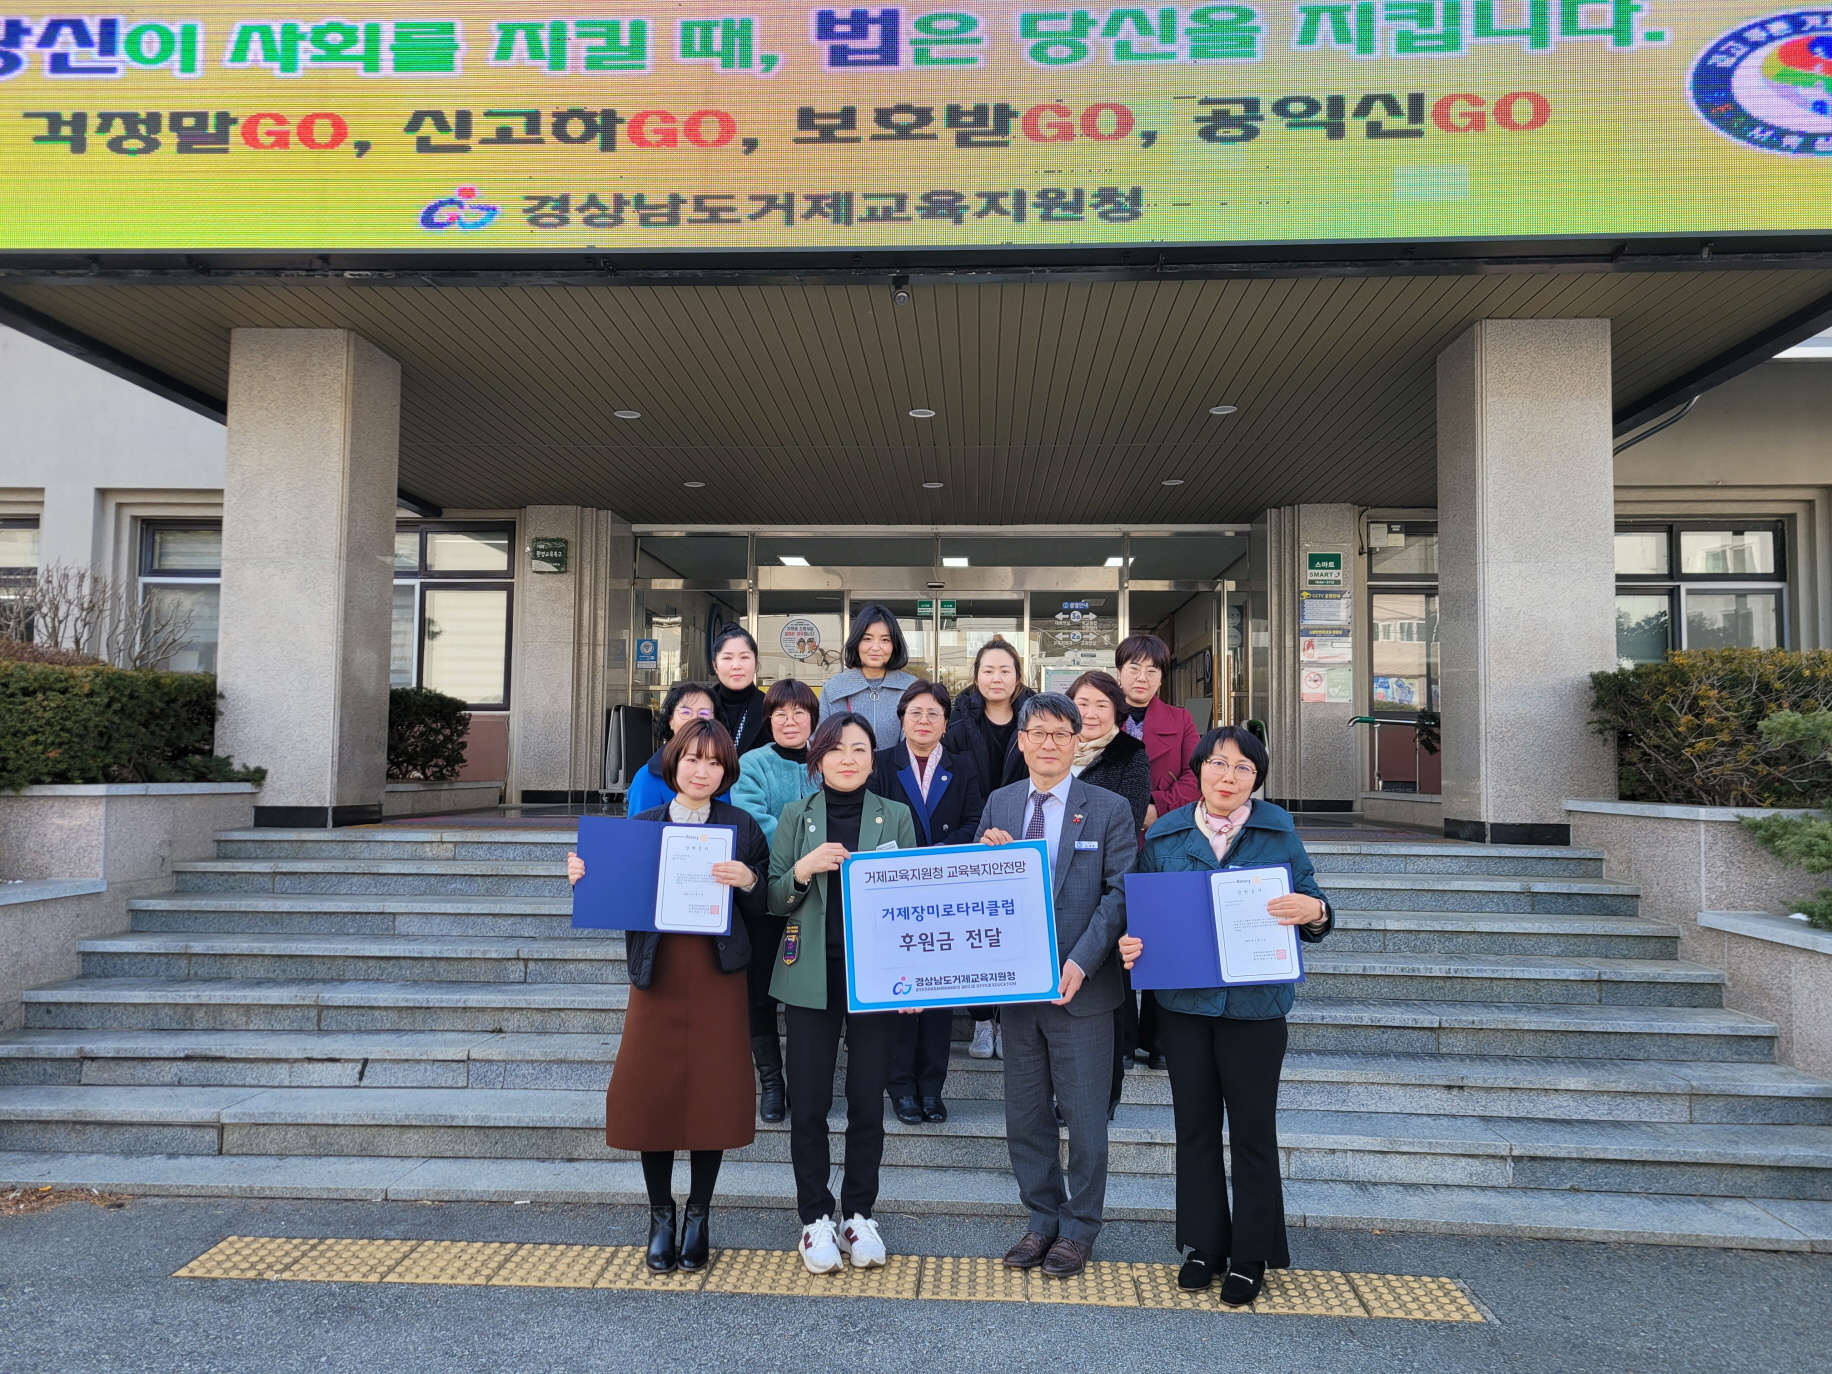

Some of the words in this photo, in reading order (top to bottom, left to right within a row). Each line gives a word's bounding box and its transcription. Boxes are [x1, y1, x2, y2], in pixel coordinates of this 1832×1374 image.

[230, 21, 460, 74] 사회를
[494, 20, 647, 72] 지킬
[679, 17, 780, 73] 때,
[815, 8, 983, 66] 법은
[1019, 7, 1262, 65] 당신을
[1298, 0, 1666, 57] 지킵니다.
[793, 102, 1158, 149] 보호받GO,
[1193, 91, 1552, 144] 공익신GO
[521, 186, 1144, 229] 경상남도거제교육지원청
[865, 866, 944, 885] 거제교육지원청
[946, 860, 1026, 879] 교육복지안전망
[881, 899, 1016, 922] 거제장미로타리클럽
[899, 931, 955, 952] 후원금
[965, 927, 1002, 949] 전달
[915, 971, 1016, 987] 경상남도거제교육지원청
